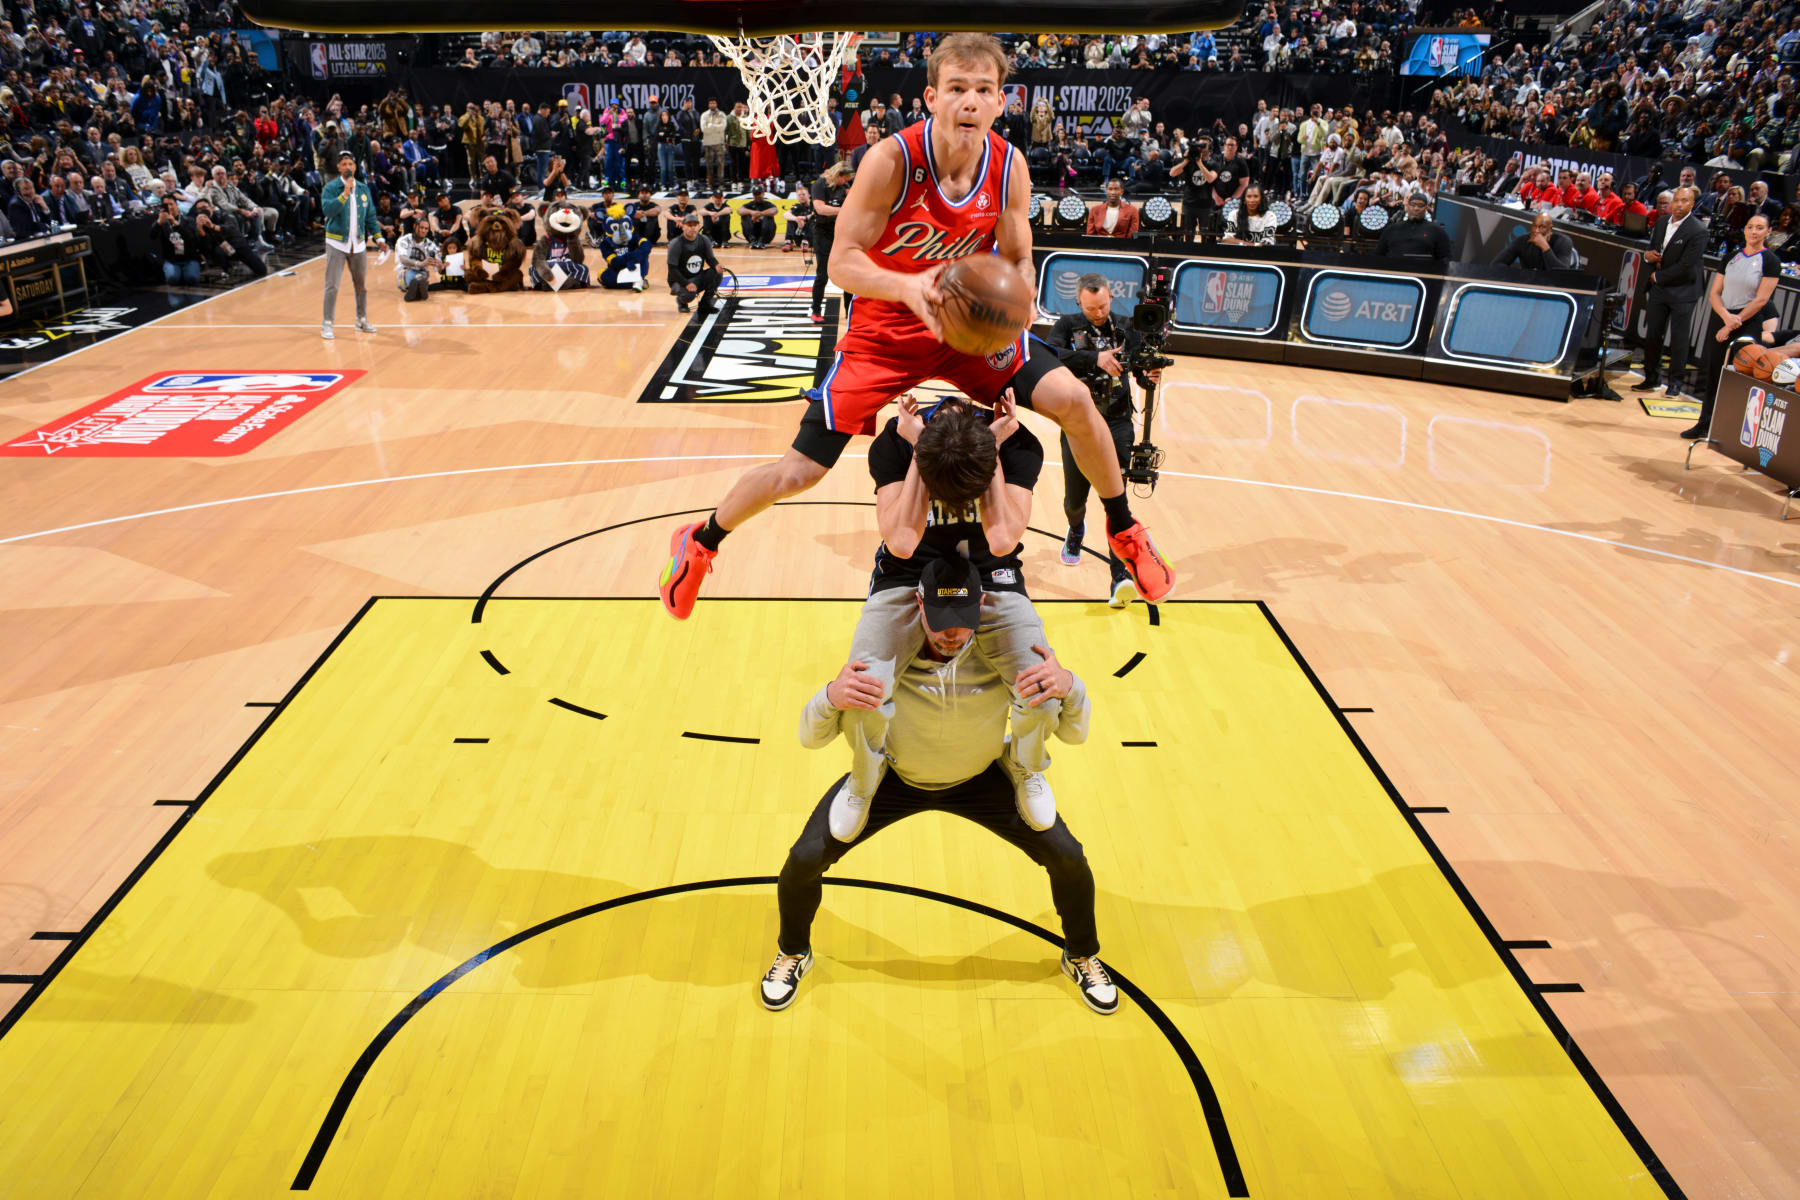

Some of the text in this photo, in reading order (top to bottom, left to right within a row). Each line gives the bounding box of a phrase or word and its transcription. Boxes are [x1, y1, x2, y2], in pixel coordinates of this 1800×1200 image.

[367, 43, 387, 60] 2023
[331, 62, 358, 74] UTAH
[1098, 86, 1133, 112] 2023
[914, 168, 925, 183] 6
[16, 278, 55, 301] SATURDAY
[1107, 280, 1139, 298] T&T
[1225, 282, 1254, 298] SLAM
[1223, 298, 1251, 313] DUNK
[1355, 300, 1412, 322] AT&T
[1773, 398, 1789, 410] AT&T
[1760, 406, 1786, 435] SLAM
[1756, 428, 1781, 456] DUNK
[937, 587, 953, 596] UTAH
